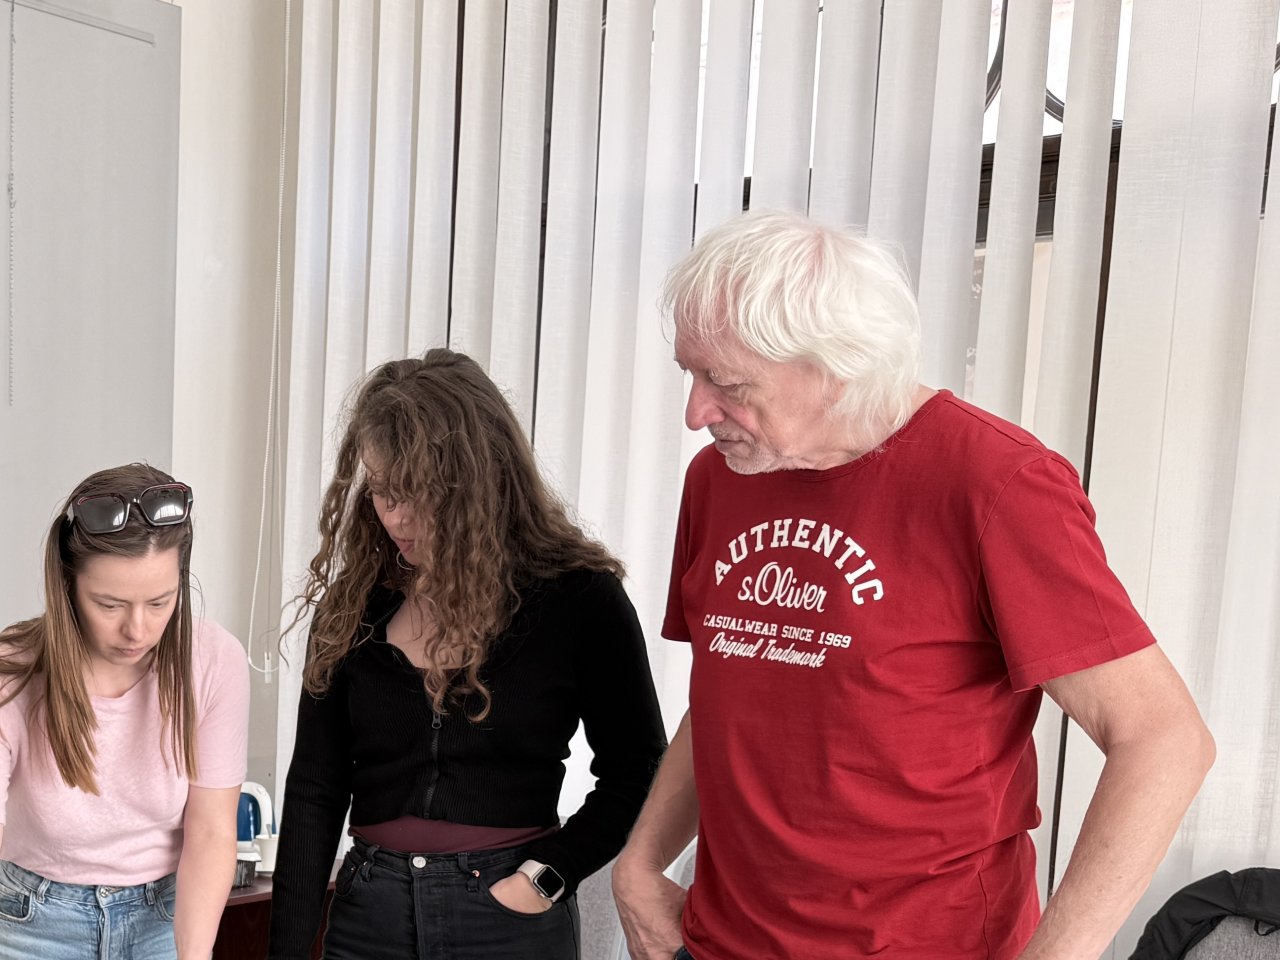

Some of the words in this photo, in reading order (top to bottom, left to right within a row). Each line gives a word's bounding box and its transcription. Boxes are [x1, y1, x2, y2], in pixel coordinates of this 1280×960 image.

[714, 518, 884, 606] AUTHENTIC
[738, 561, 827, 613] s.Oliver
[703, 613, 778, 637] CASUALWEAR
[781, 625, 814, 643] SINCE
[817, 631, 852, 649] 1969
[709, 632, 764, 660] Original
[761, 639, 827, 668] Trademark
